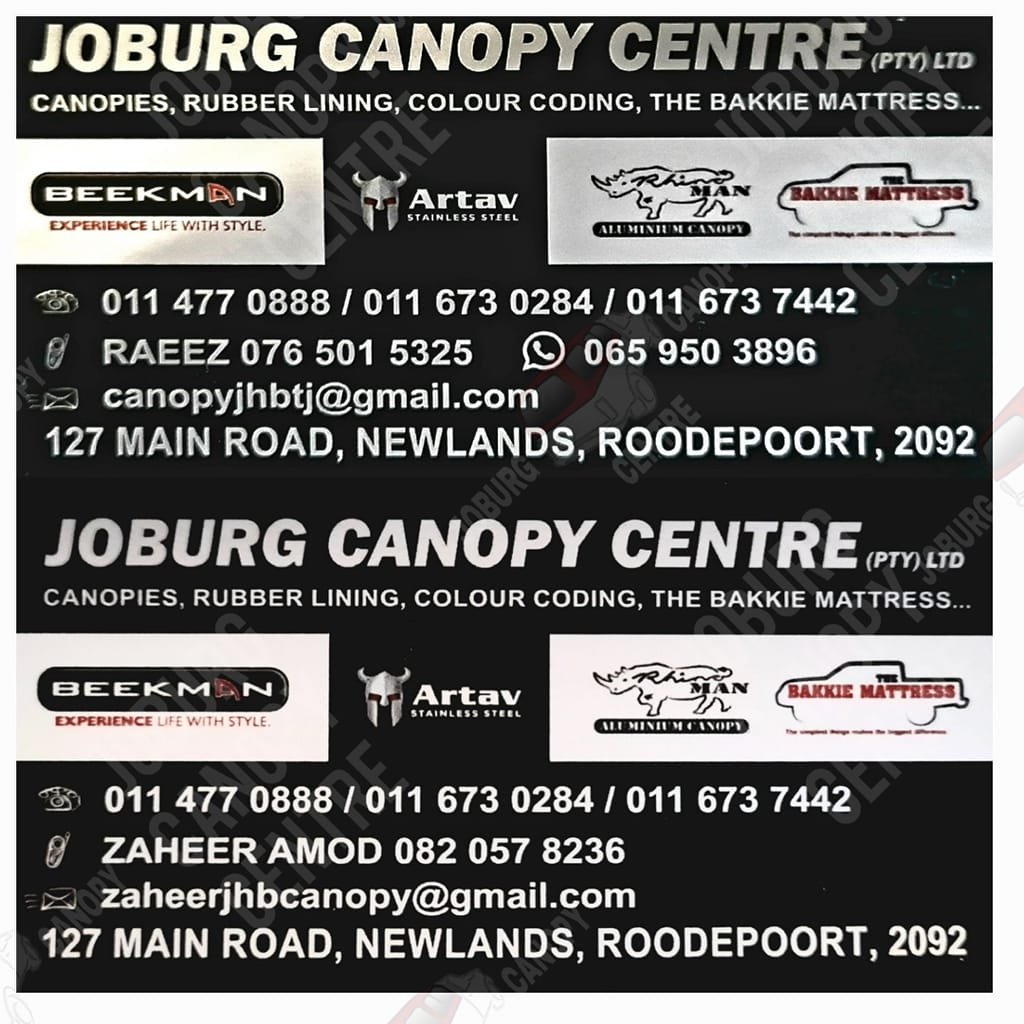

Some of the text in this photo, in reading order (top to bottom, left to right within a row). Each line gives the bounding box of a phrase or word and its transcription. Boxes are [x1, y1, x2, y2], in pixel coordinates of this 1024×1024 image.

[30, 21, 974, 73] JOBURG CANOPY CENTRE (PTY) LTD
[31, 92, 980, 116] CANOPIES, RUBBER LINING, COLOUR CODING, THE BAKKIE MATTRESS...
[689, 184, 751, 197] MAN
[882, 176, 904, 186] THE
[44, 182, 267, 206] BEEKMAN
[409, 189, 518, 209] Artav
[789, 186, 965, 202] BAKKIE MATTRESS
[50, 220, 266, 232] EXPERIENCE LIFE WITH STYLE.
[407, 213, 519, 222] STAINLESS STEEL
[598, 223, 745, 236] ALUMINIUM CANOPY
[102, 286, 856, 316] 011 477 0888 / 011 673 0284 / 011 673 7442
[103, 337, 817, 366] RAEEZ 076 501 5325 065 950 3896
[103, 381, 539, 416] canopyjhbtj@gmail.com
[46, 425, 975, 463] 127 MAIN ROAD, NEWLANDS, ROODEPOORT, 2092
[44, 518, 307, 568] JOBURG
[327, 518, 597, 569] CANOPY
[611, 519, 863, 569] CENTRE
[866, 551, 921, 572] (PTY)
[925, 551, 965, 569] LTD
[43, 588, 971, 611] CANOPIES, RUBBER LINING, COLOUR CODING, THE BAKKIE MATTRESS...
[689, 682, 750, 695] MAN
[876, 673, 898, 683] THE
[52, 679, 273, 701] BEEKMAN
[413, 685, 521, 705] Artav
[787, 684, 956, 699] BAKKIE MATTRESS
[54, 715, 271, 728] EXPERIENCE LIFE WITH STYLE.
[410, 709, 521, 718] STAINLESS STEEL
[601, 720, 744, 733] ALUMINIUM CANOPY
[104, 785, 852, 814] 011 477 0888 / 011 673 0284 / 011 673 7442
[101, 836, 626, 865] ZAHEER AMOD 082 057 8236
[100, 881, 636, 917] zaheerjhbcanopy@gmail.com
[42, 924, 968, 965] 127 MAIN ROAD, NEWLANDS, ROODEPOORT, 2092
